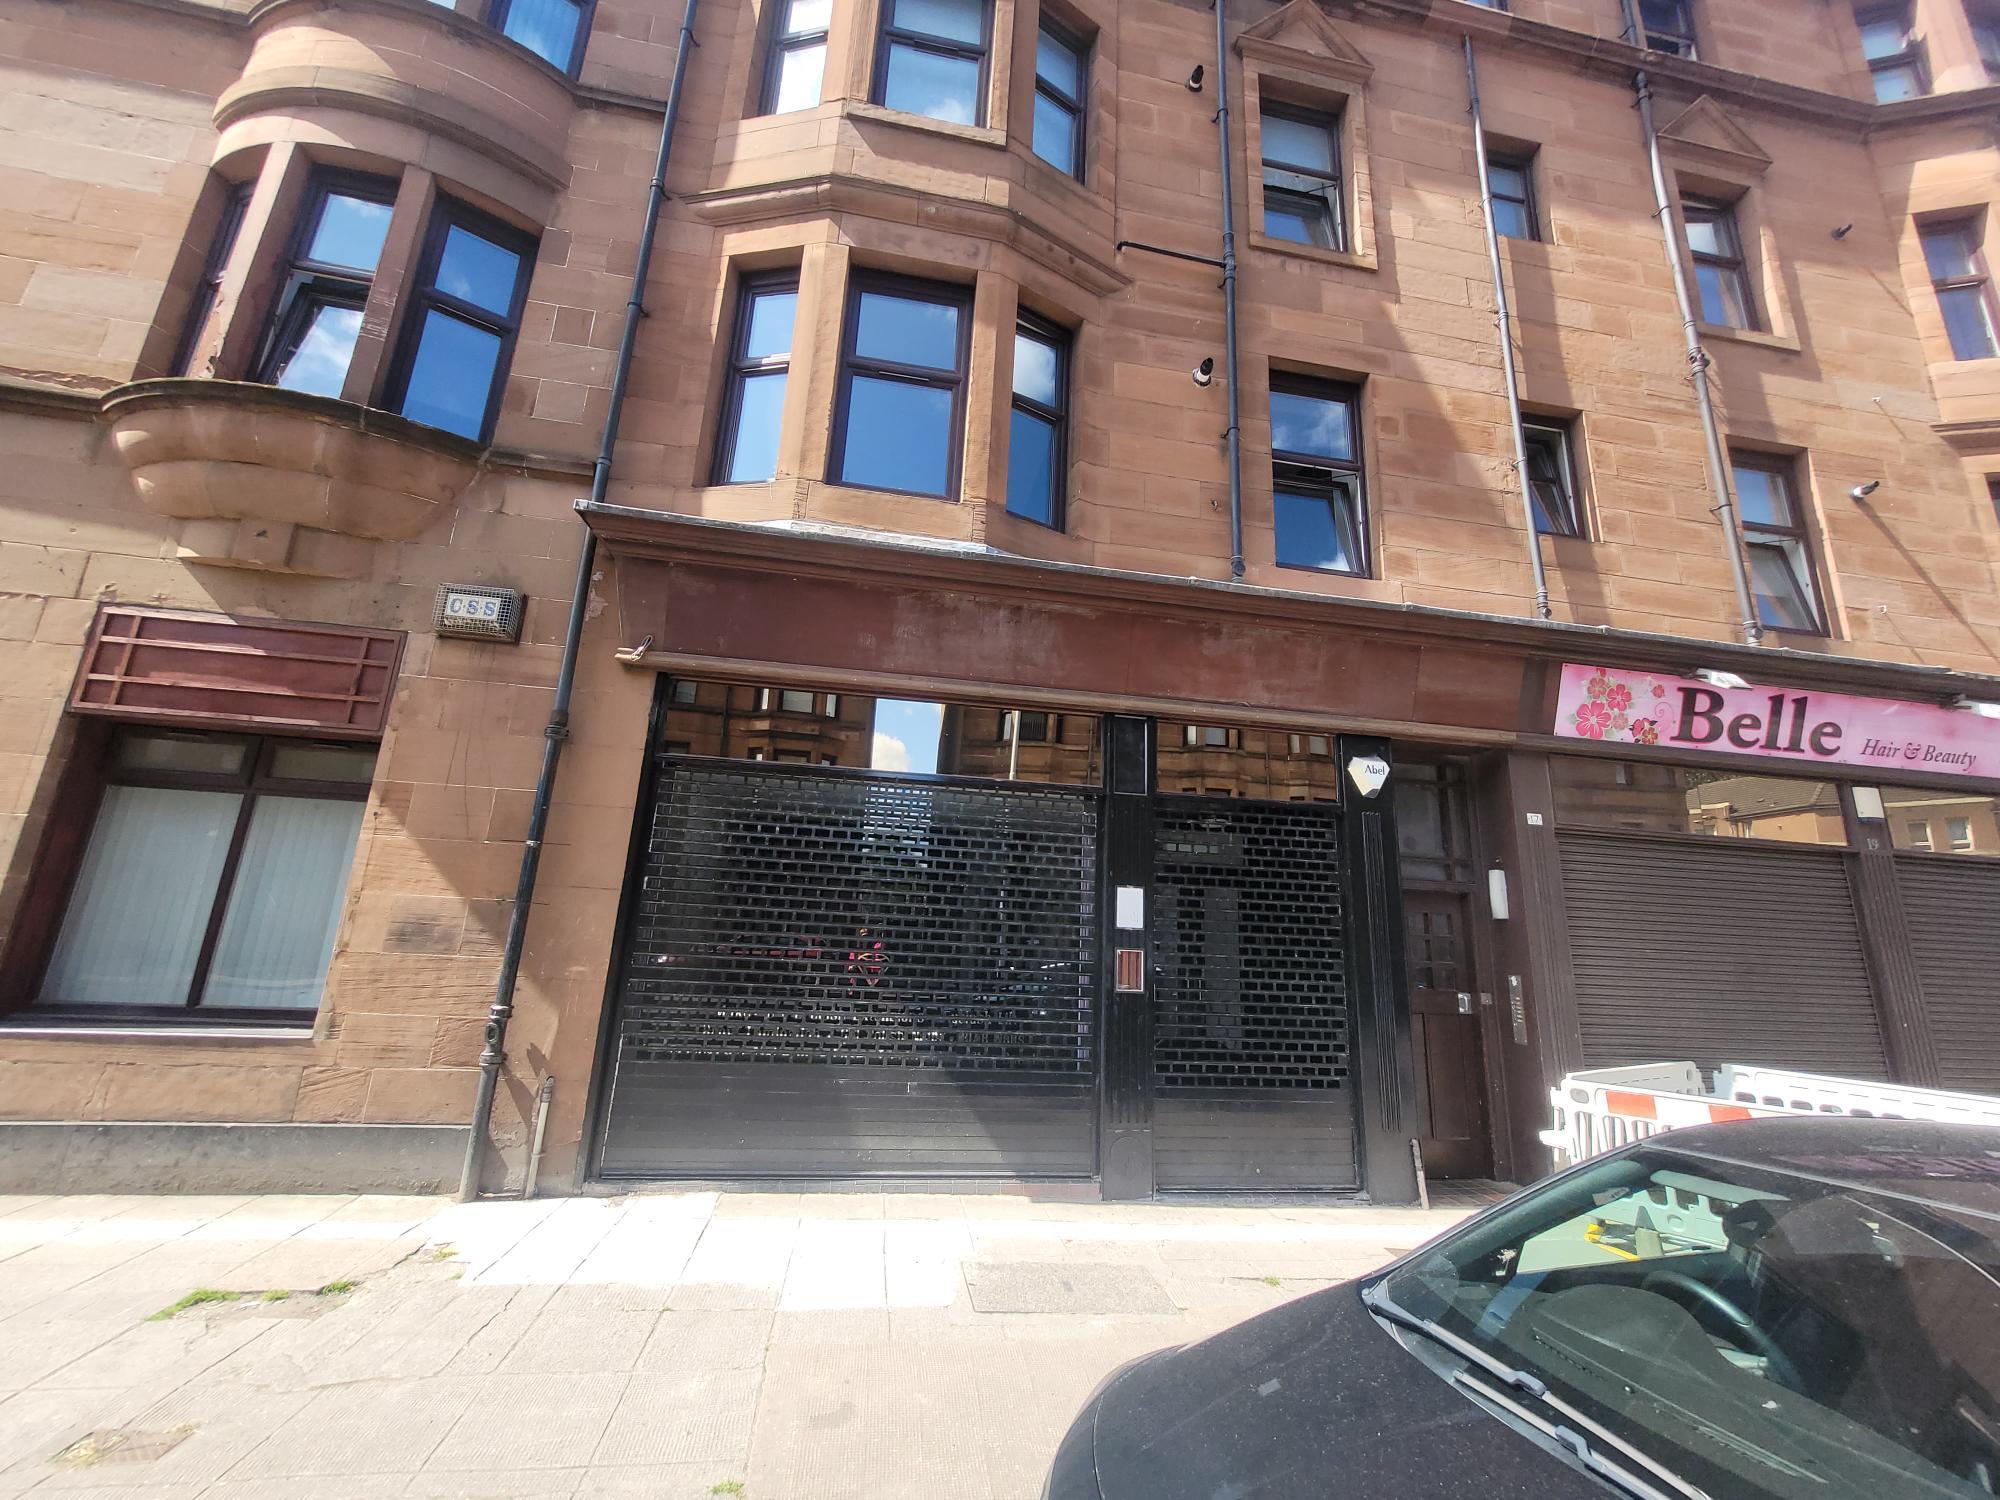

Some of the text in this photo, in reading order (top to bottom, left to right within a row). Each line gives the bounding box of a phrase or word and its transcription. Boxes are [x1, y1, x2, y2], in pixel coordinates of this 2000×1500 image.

[1669, 685, 1842, 757] Belle
[1364, 764, 1386, 776] Abel
[1859, 737, 1978, 772] Hair & Beauty
